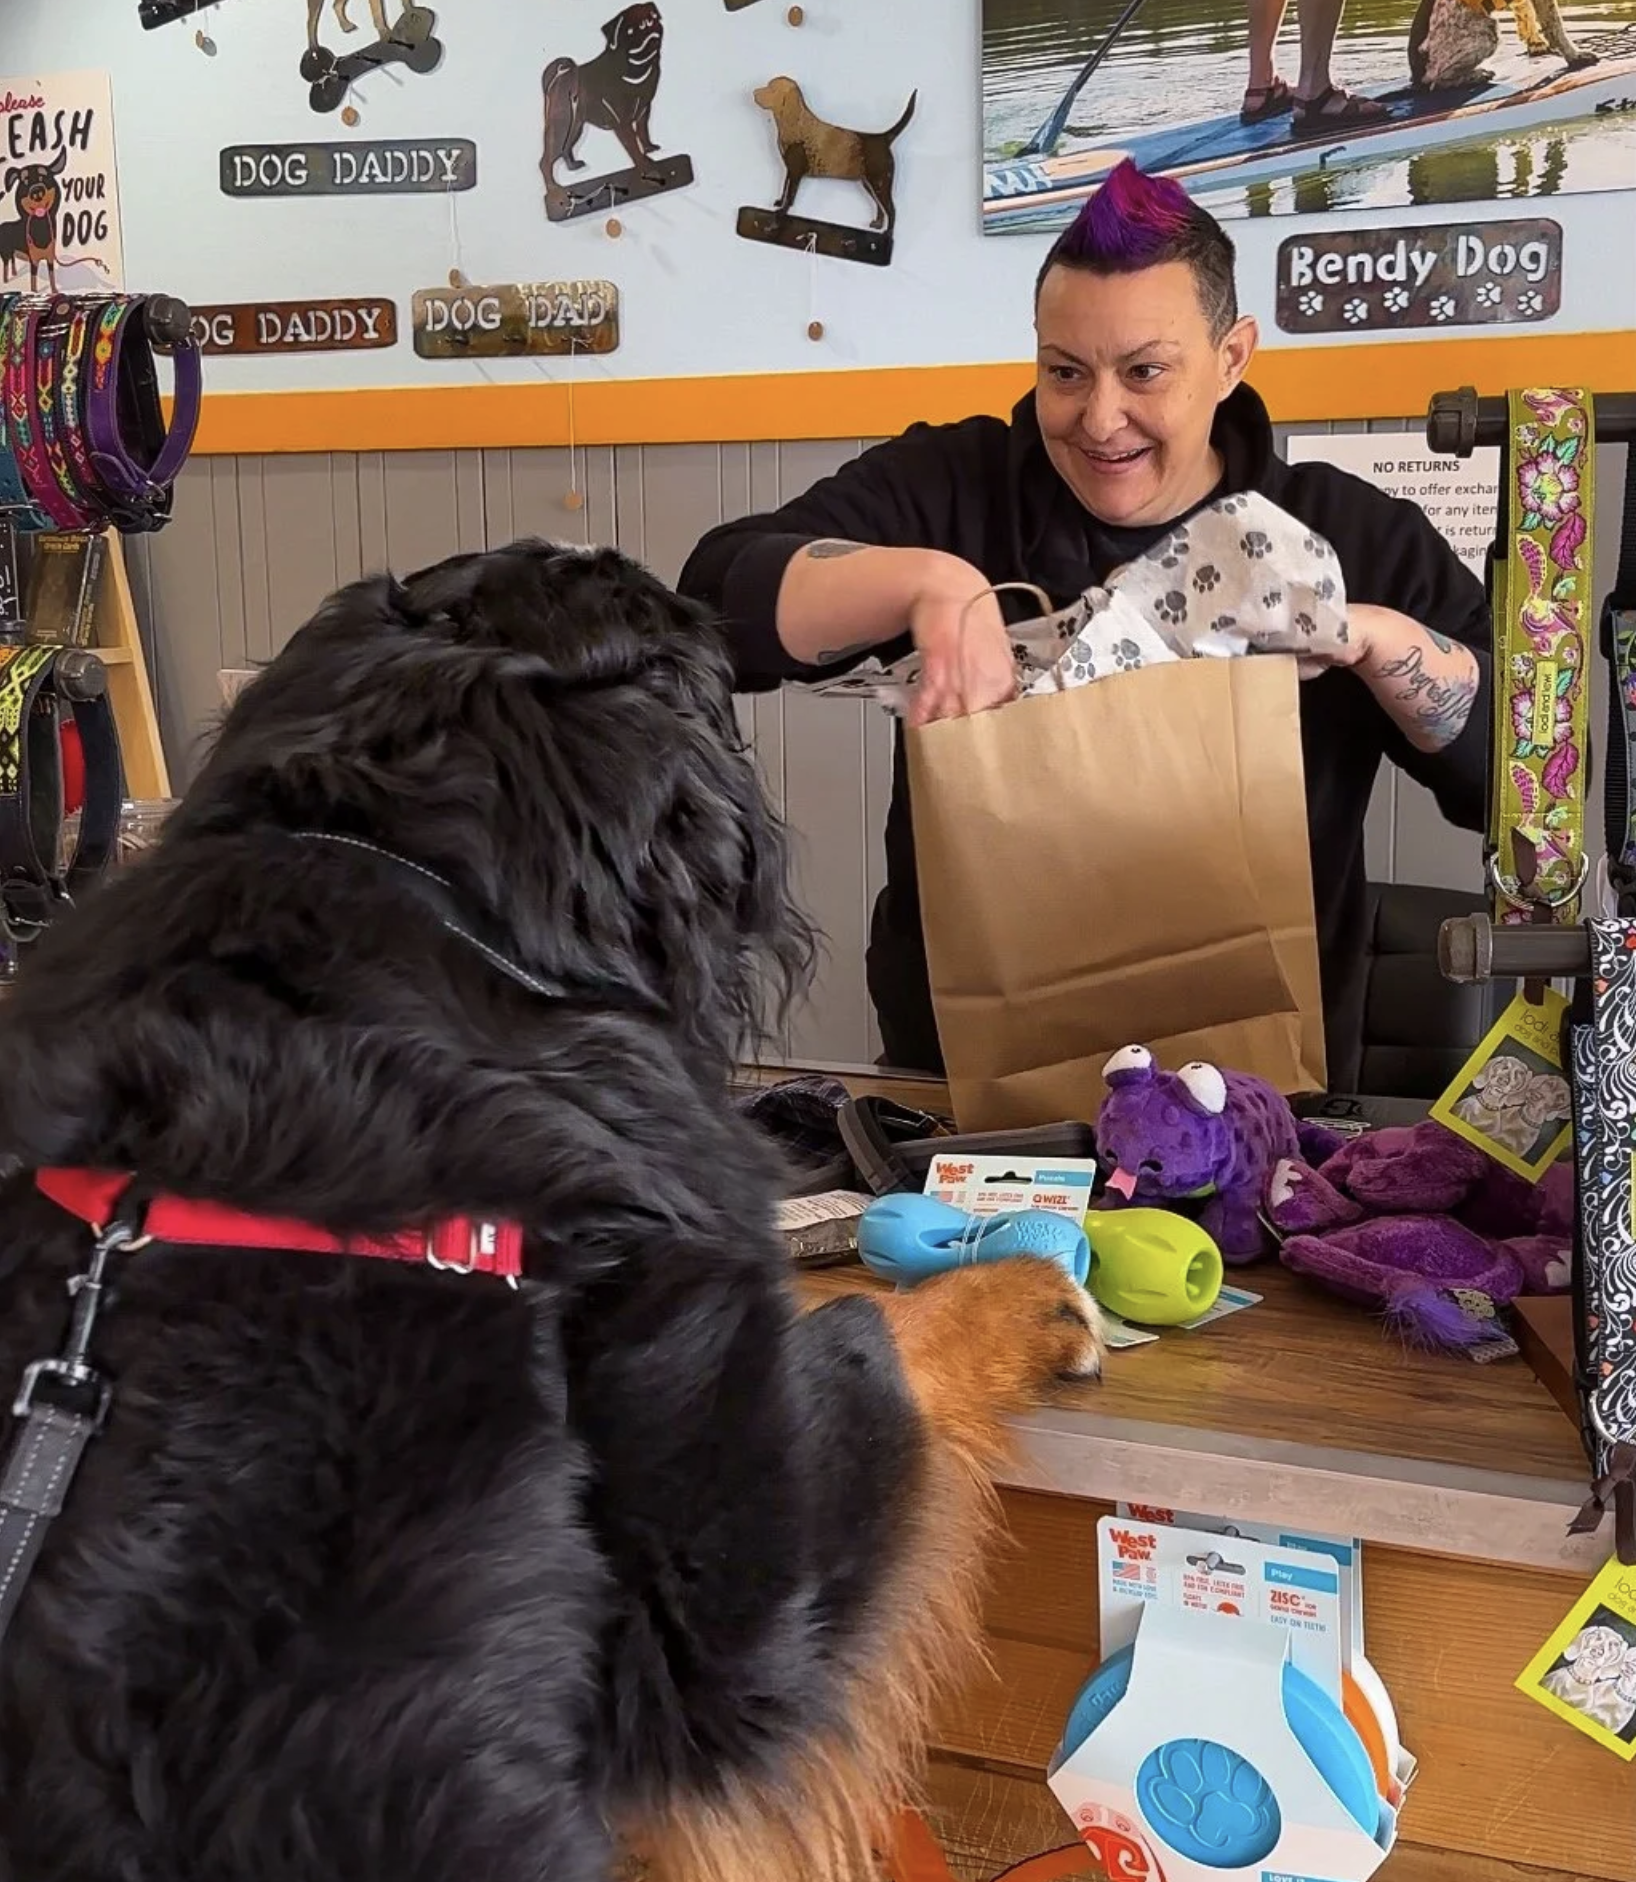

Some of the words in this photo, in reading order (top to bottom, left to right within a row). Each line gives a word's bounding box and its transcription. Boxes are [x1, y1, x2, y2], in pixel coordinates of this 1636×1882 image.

[0, 109, 94, 164] EASH
[233, 153, 308, 187] DOG
[332, 149, 461, 185] DADDY
[62, 172, 105, 202] YOUR
[61, 210, 108, 247] DOG
[1290, 240, 1437, 287] Bendy
[1456, 235, 1549, 282] Dog
[425, 297, 501, 331] DOG
[528, 291, 605, 328] DAD
[189, 313, 235, 347] OG
[257, 307, 381, 343] DADDY
[1373, 462, 1394, 473] NO
[1398, 460, 1460, 472] RETURNS
[1402, 485, 1416, 496] to
[1419, 483, 1451, 496] offer
[1445, 506, 1469, 518] any
[1446, 525, 1455, 536] is
[936, 1162, 974, 1174] West
[1127, 1503, 1174, 1523] West
[1109, 1528, 1156, 1549] West
[1118, 1544, 1151, 1560] Paw
